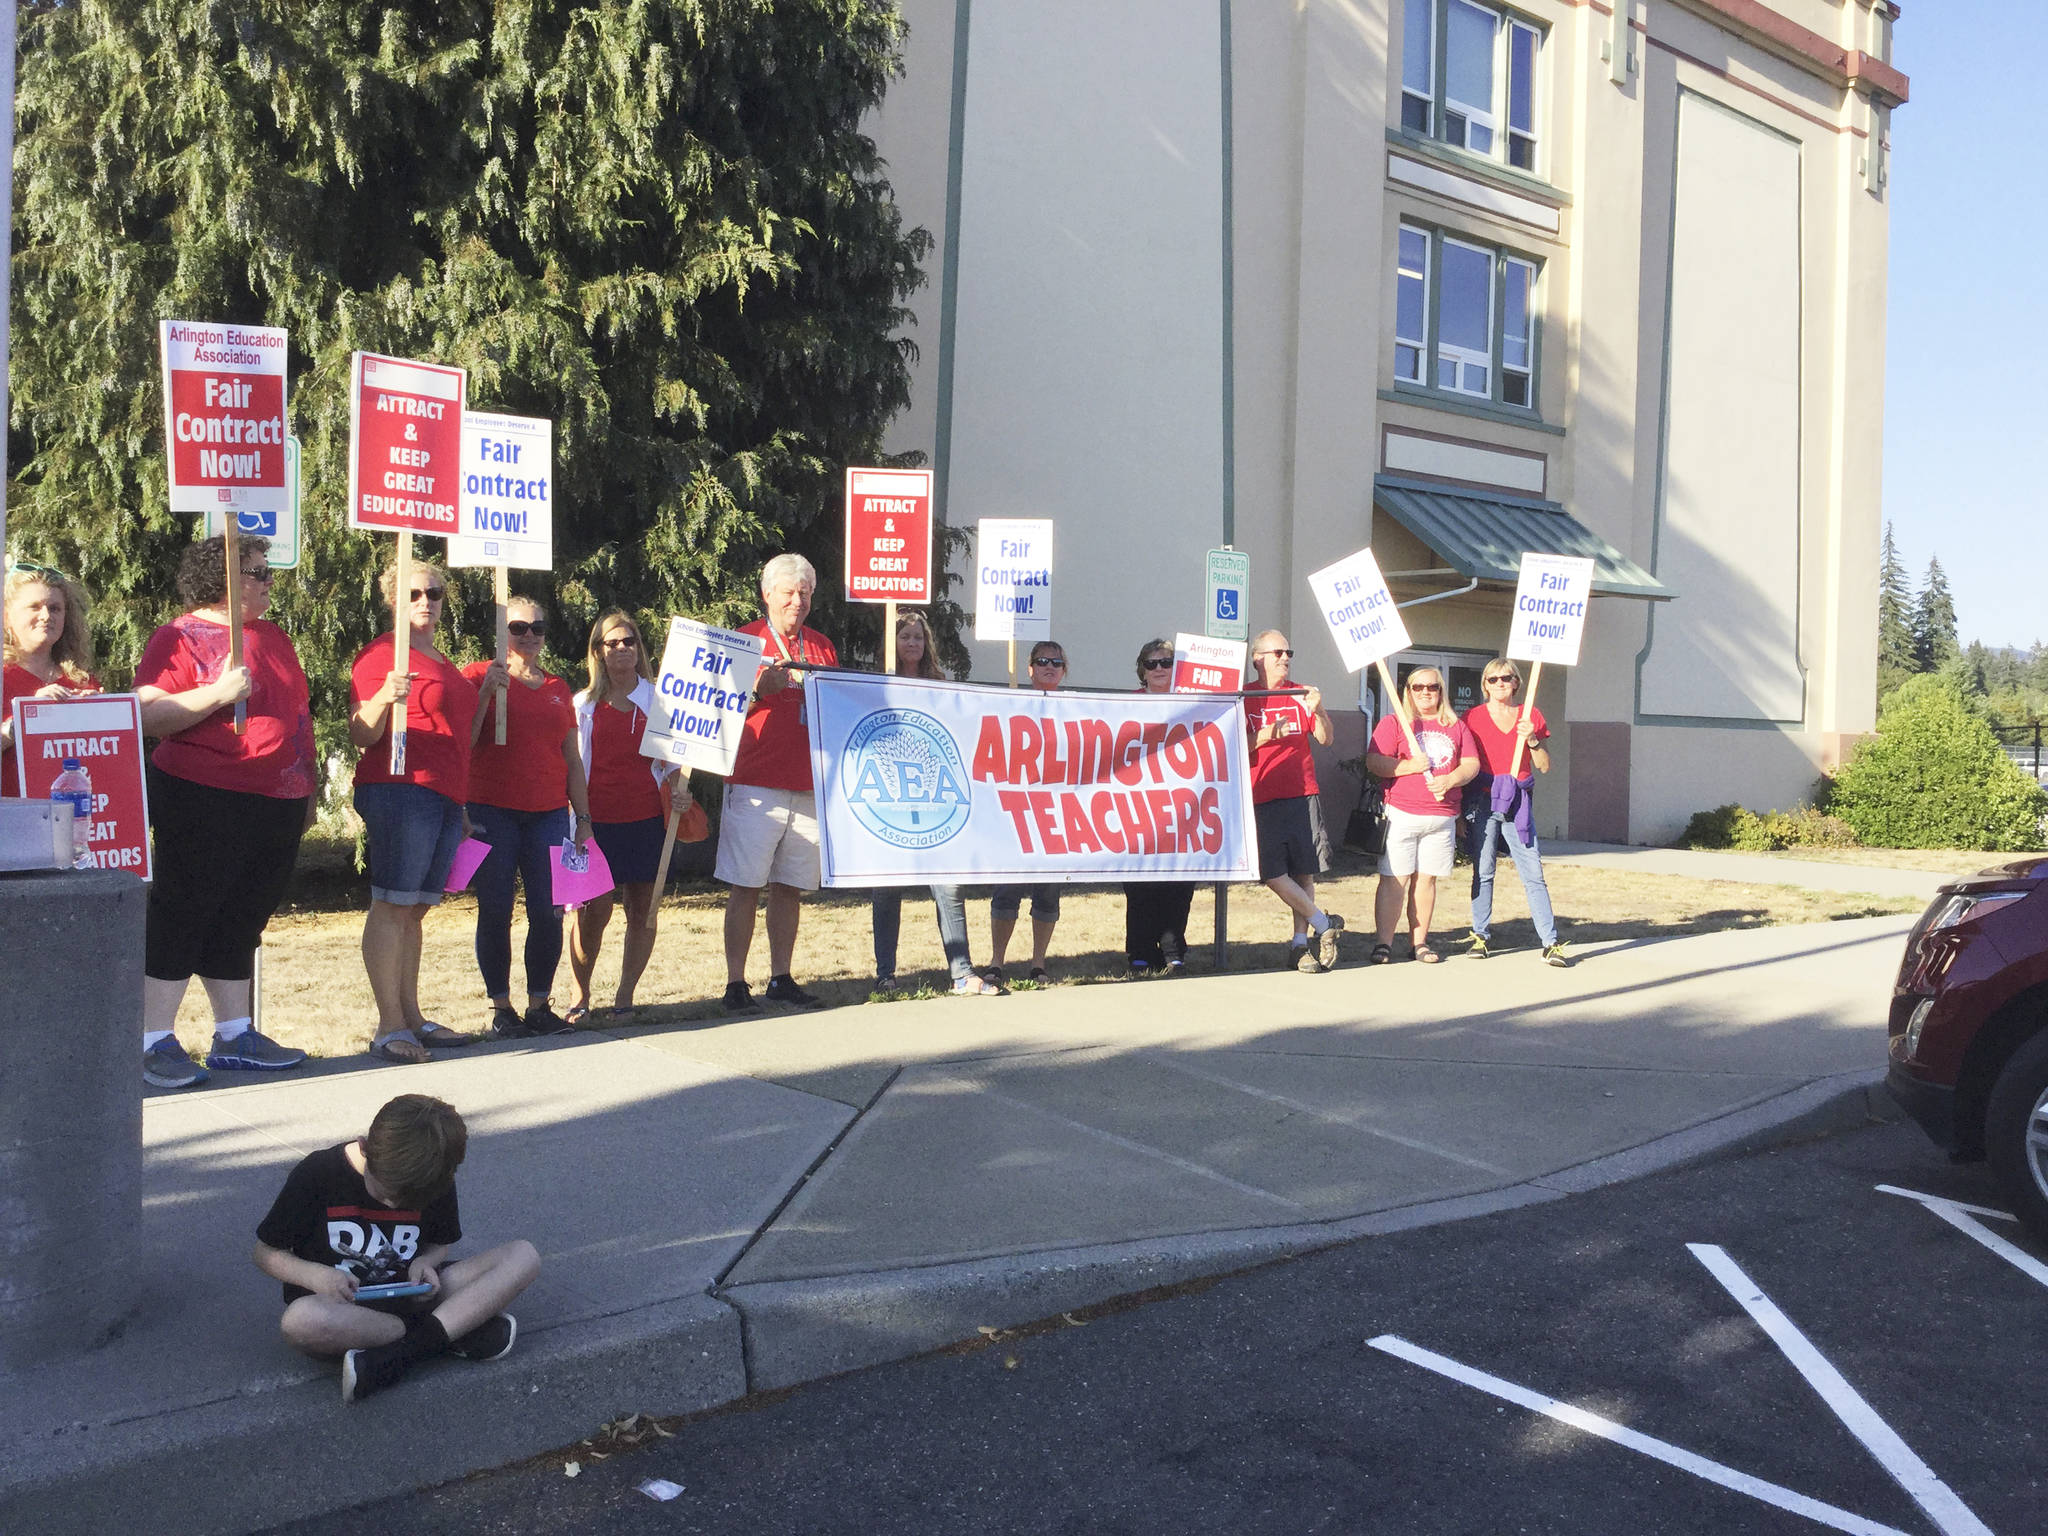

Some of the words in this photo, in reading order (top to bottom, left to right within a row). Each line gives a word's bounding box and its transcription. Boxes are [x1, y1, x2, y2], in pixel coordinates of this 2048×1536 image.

[169, 326, 223, 347] Arlington
[227, 330, 283, 348] Education
[194, 347, 261, 365] Association
[205, 378, 252, 408] Fair
[377, 394, 445, 420] ATTRACT
[176, 412, 282, 445] Contract
[404, 423, 418, 441] &
[389, 446, 431, 468] KEEP
[481, 437, 522, 464] Fair
[200, 449, 261, 479] Now!
[384, 471, 435, 494] GREAT
[464, 472, 547, 501] ontract
[362, 494, 455, 522] EDUCATORS
[864, 498, 916, 513] ATTRACT
[474, 506, 527, 534] Now!
[884, 518, 895, 532] &
[873, 538, 905, 552] KEEP
[1001, 539, 1031, 558] Fair
[869, 557, 909, 572] GREAT
[1211, 556, 1246, 571] RESERVED
[853, 576, 924, 592] EDUCATORS
[982, 566, 1049, 587] Contract
[1212, 572, 1244, 586] PARKING
[1334, 576, 1361, 598] Fair
[1540, 572, 1570, 591] Fair
[994, 594, 1033, 614] Now!
[1329, 588, 1389, 627] Contract
[1519, 595, 1583, 617] Contract
[725, 634, 746, 646] Deserve
[1349, 615, 1387, 643] Now!
[1528, 620, 1566, 640] Now!
[692, 646, 733, 675] Fair
[1190, 642, 1234, 657] Arlington
[1192, 667, 1223, 688] FAIR
[661, 672, 748, 713] Contract
[1458, 686, 1471, 697] NO
[669, 708, 722, 740] Now!
[43, 736, 120, 759] ATTRACT
[848, 713, 898, 760] Arlington
[901, 711, 959, 766] Education
[848, 759, 970, 805] AEA
[87, 821, 117, 842] EAT
[997, 787, 1223, 855] TEACHERS
[878, 825, 952, 847] Association
[89, 847, 142, 869] ATORS
[327, 1221, 420, 1260] DAB
